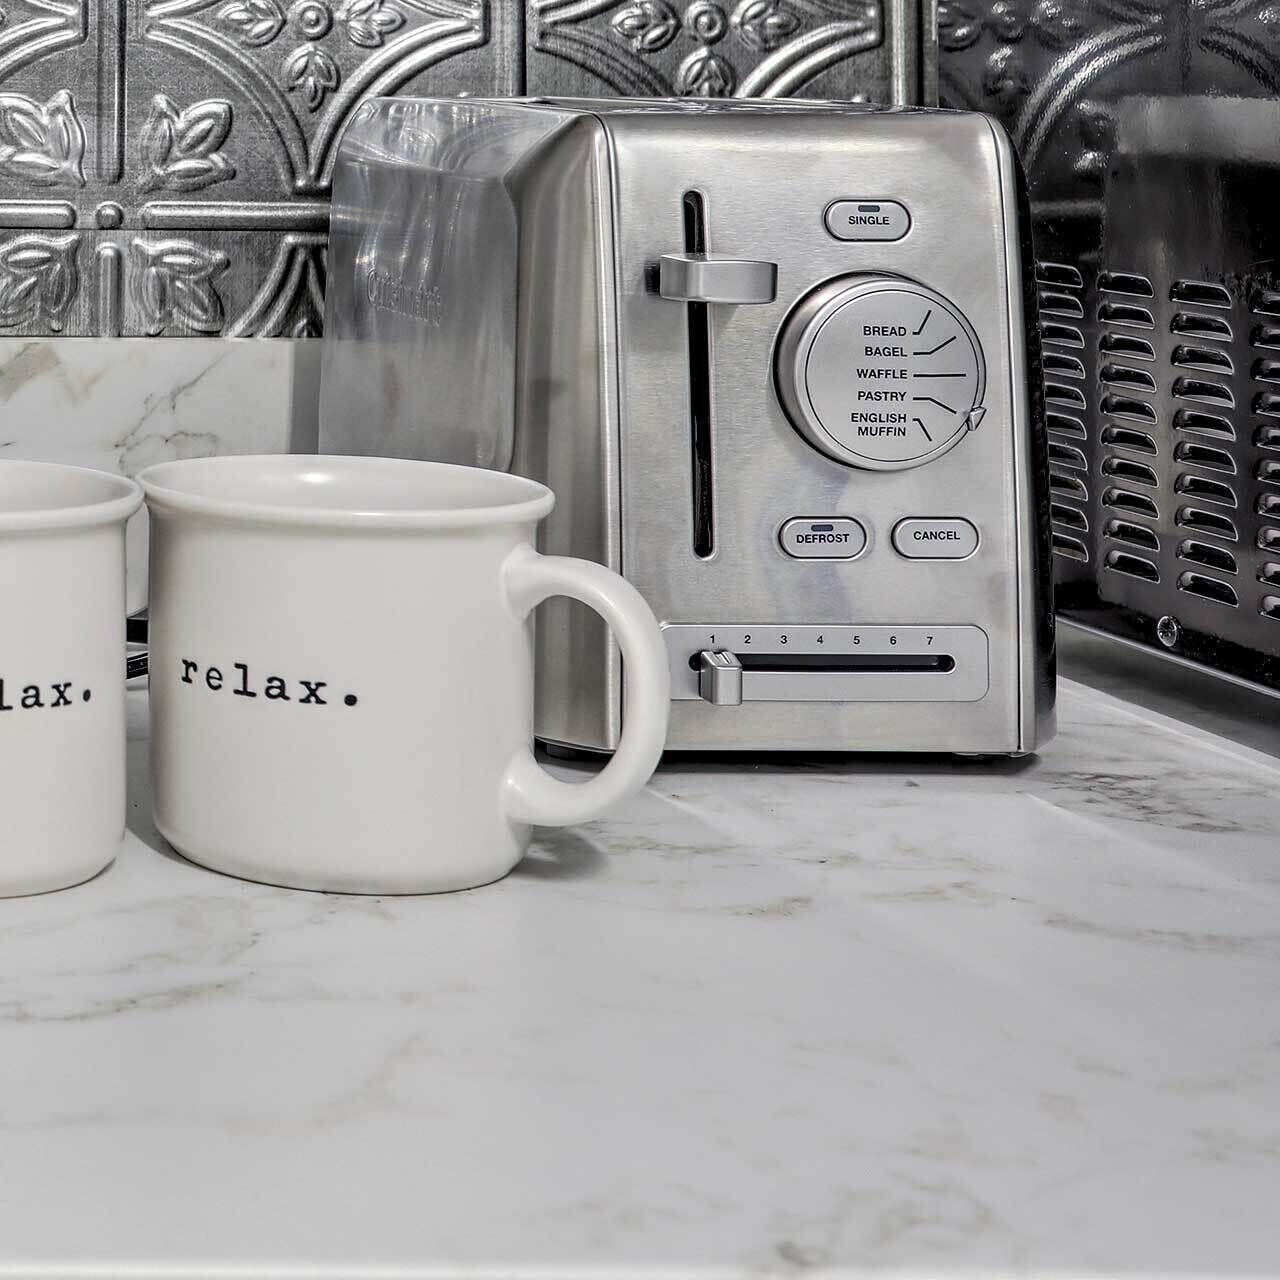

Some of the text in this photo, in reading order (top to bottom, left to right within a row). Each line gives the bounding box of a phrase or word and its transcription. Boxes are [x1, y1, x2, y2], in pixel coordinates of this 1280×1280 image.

[848, 215, 890, 225] SINGLE
[863, 325, 907, 337] BREAD
[864, 346, 908, 357] BAGEL
[856, 368, 908, 379] WAFFLE
[857, 390, 907, 401] PASTRY
[850, 412, 907, 423] ENGLISH
[857, 426, 906, 437] MUFFIN
[796, 533, 850, 544] DEFROST
[913, 531, 961, 541] CANCEL
[709, 635, 934, 645] 1 2 3 4 5 6 7
[179, 658, 358, 707] relax.
